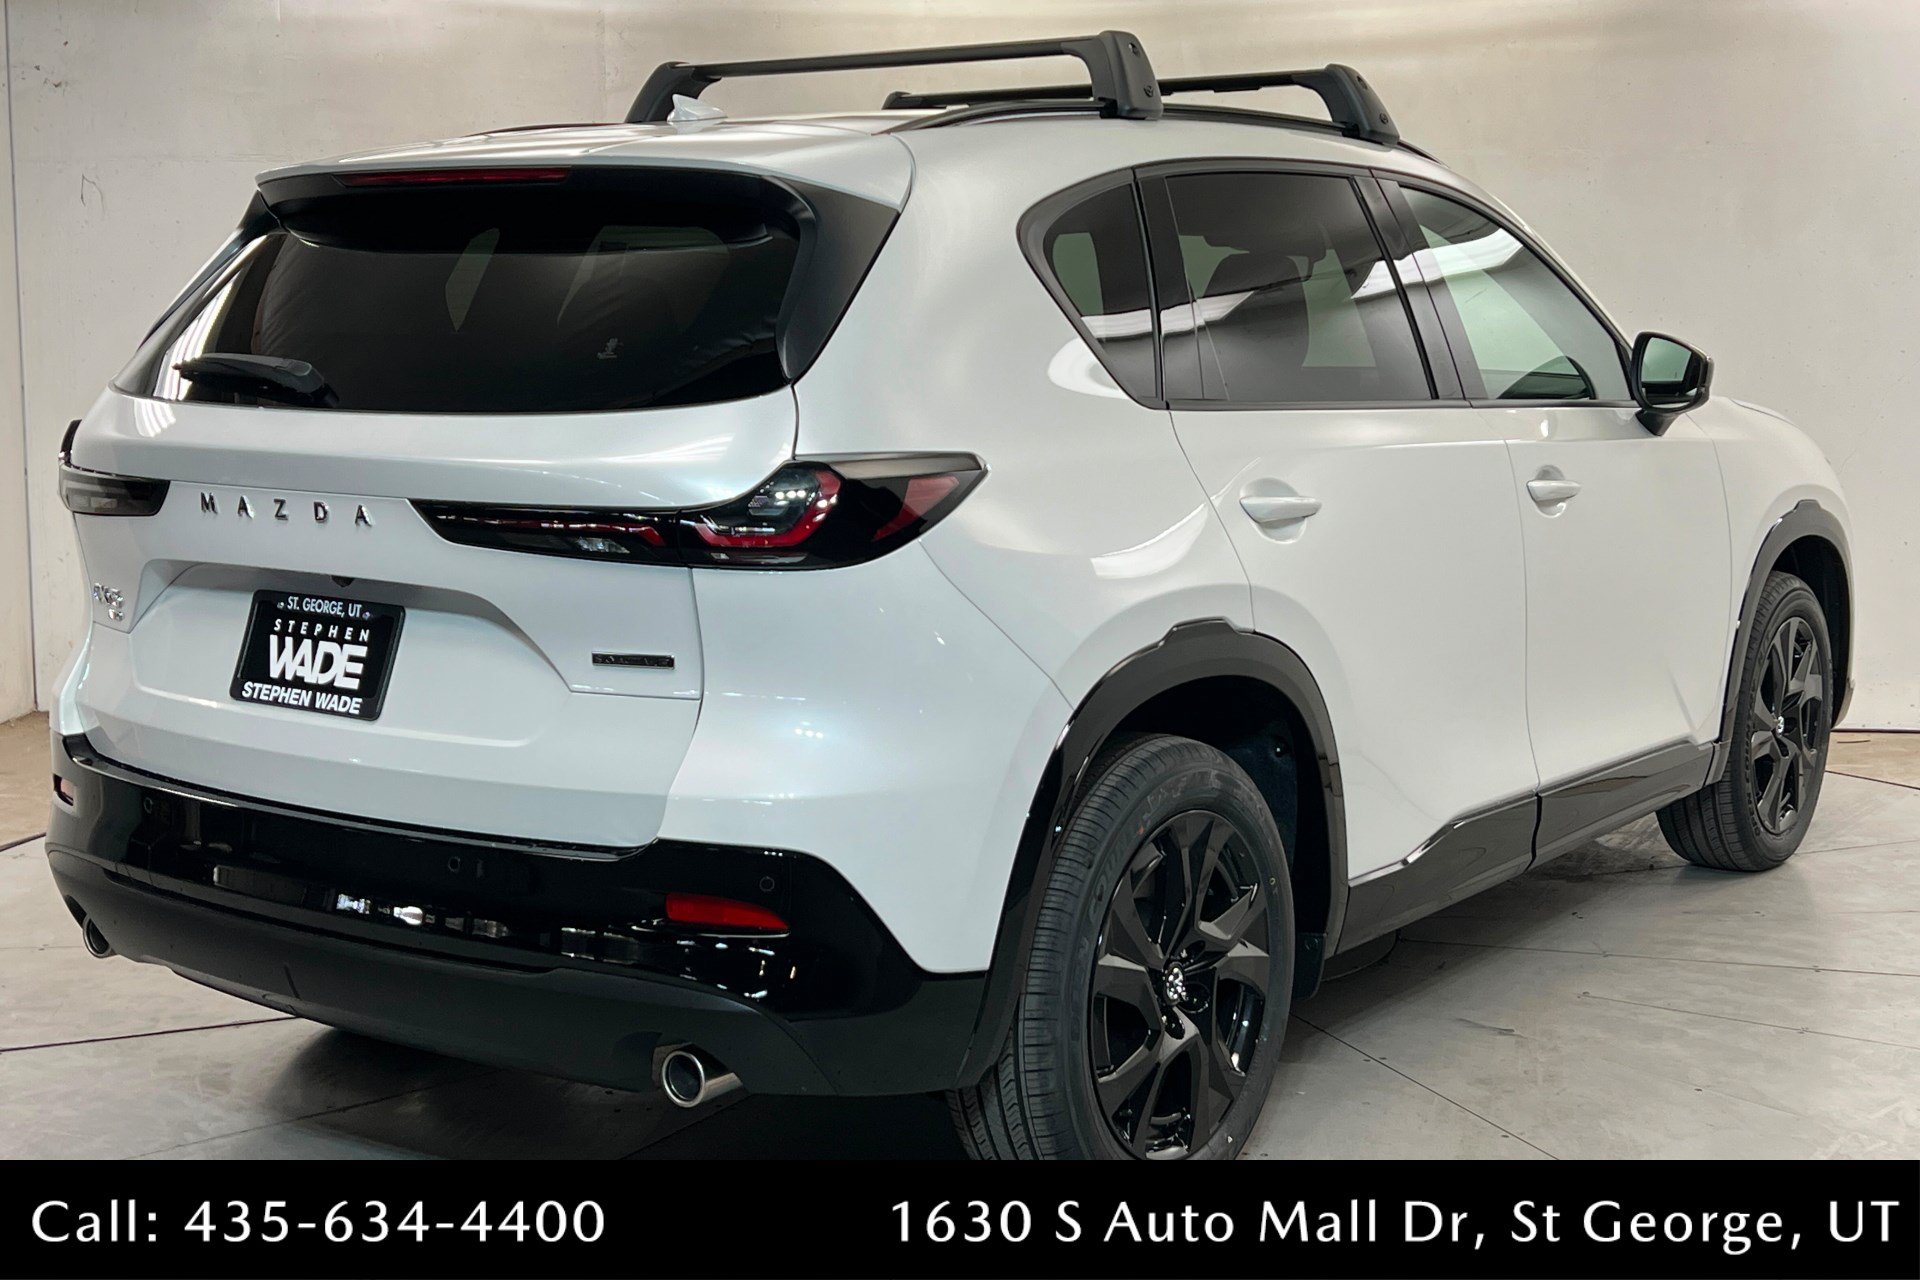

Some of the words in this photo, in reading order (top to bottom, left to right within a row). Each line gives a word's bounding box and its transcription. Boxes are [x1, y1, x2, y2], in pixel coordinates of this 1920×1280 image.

[201, 491, 373, 527] MAZDA
[287, 596, 300, 611] ST.
[303, 597, 345, 618] GEORGE,
[348, 603, 363, 618] UT
[273, 618, 370, 642] STEPHEN
[269, 634, 368, 690] WADE
[242, 681, 312, 707] STEPHEN
[315, 691, 362, 715] WADE
